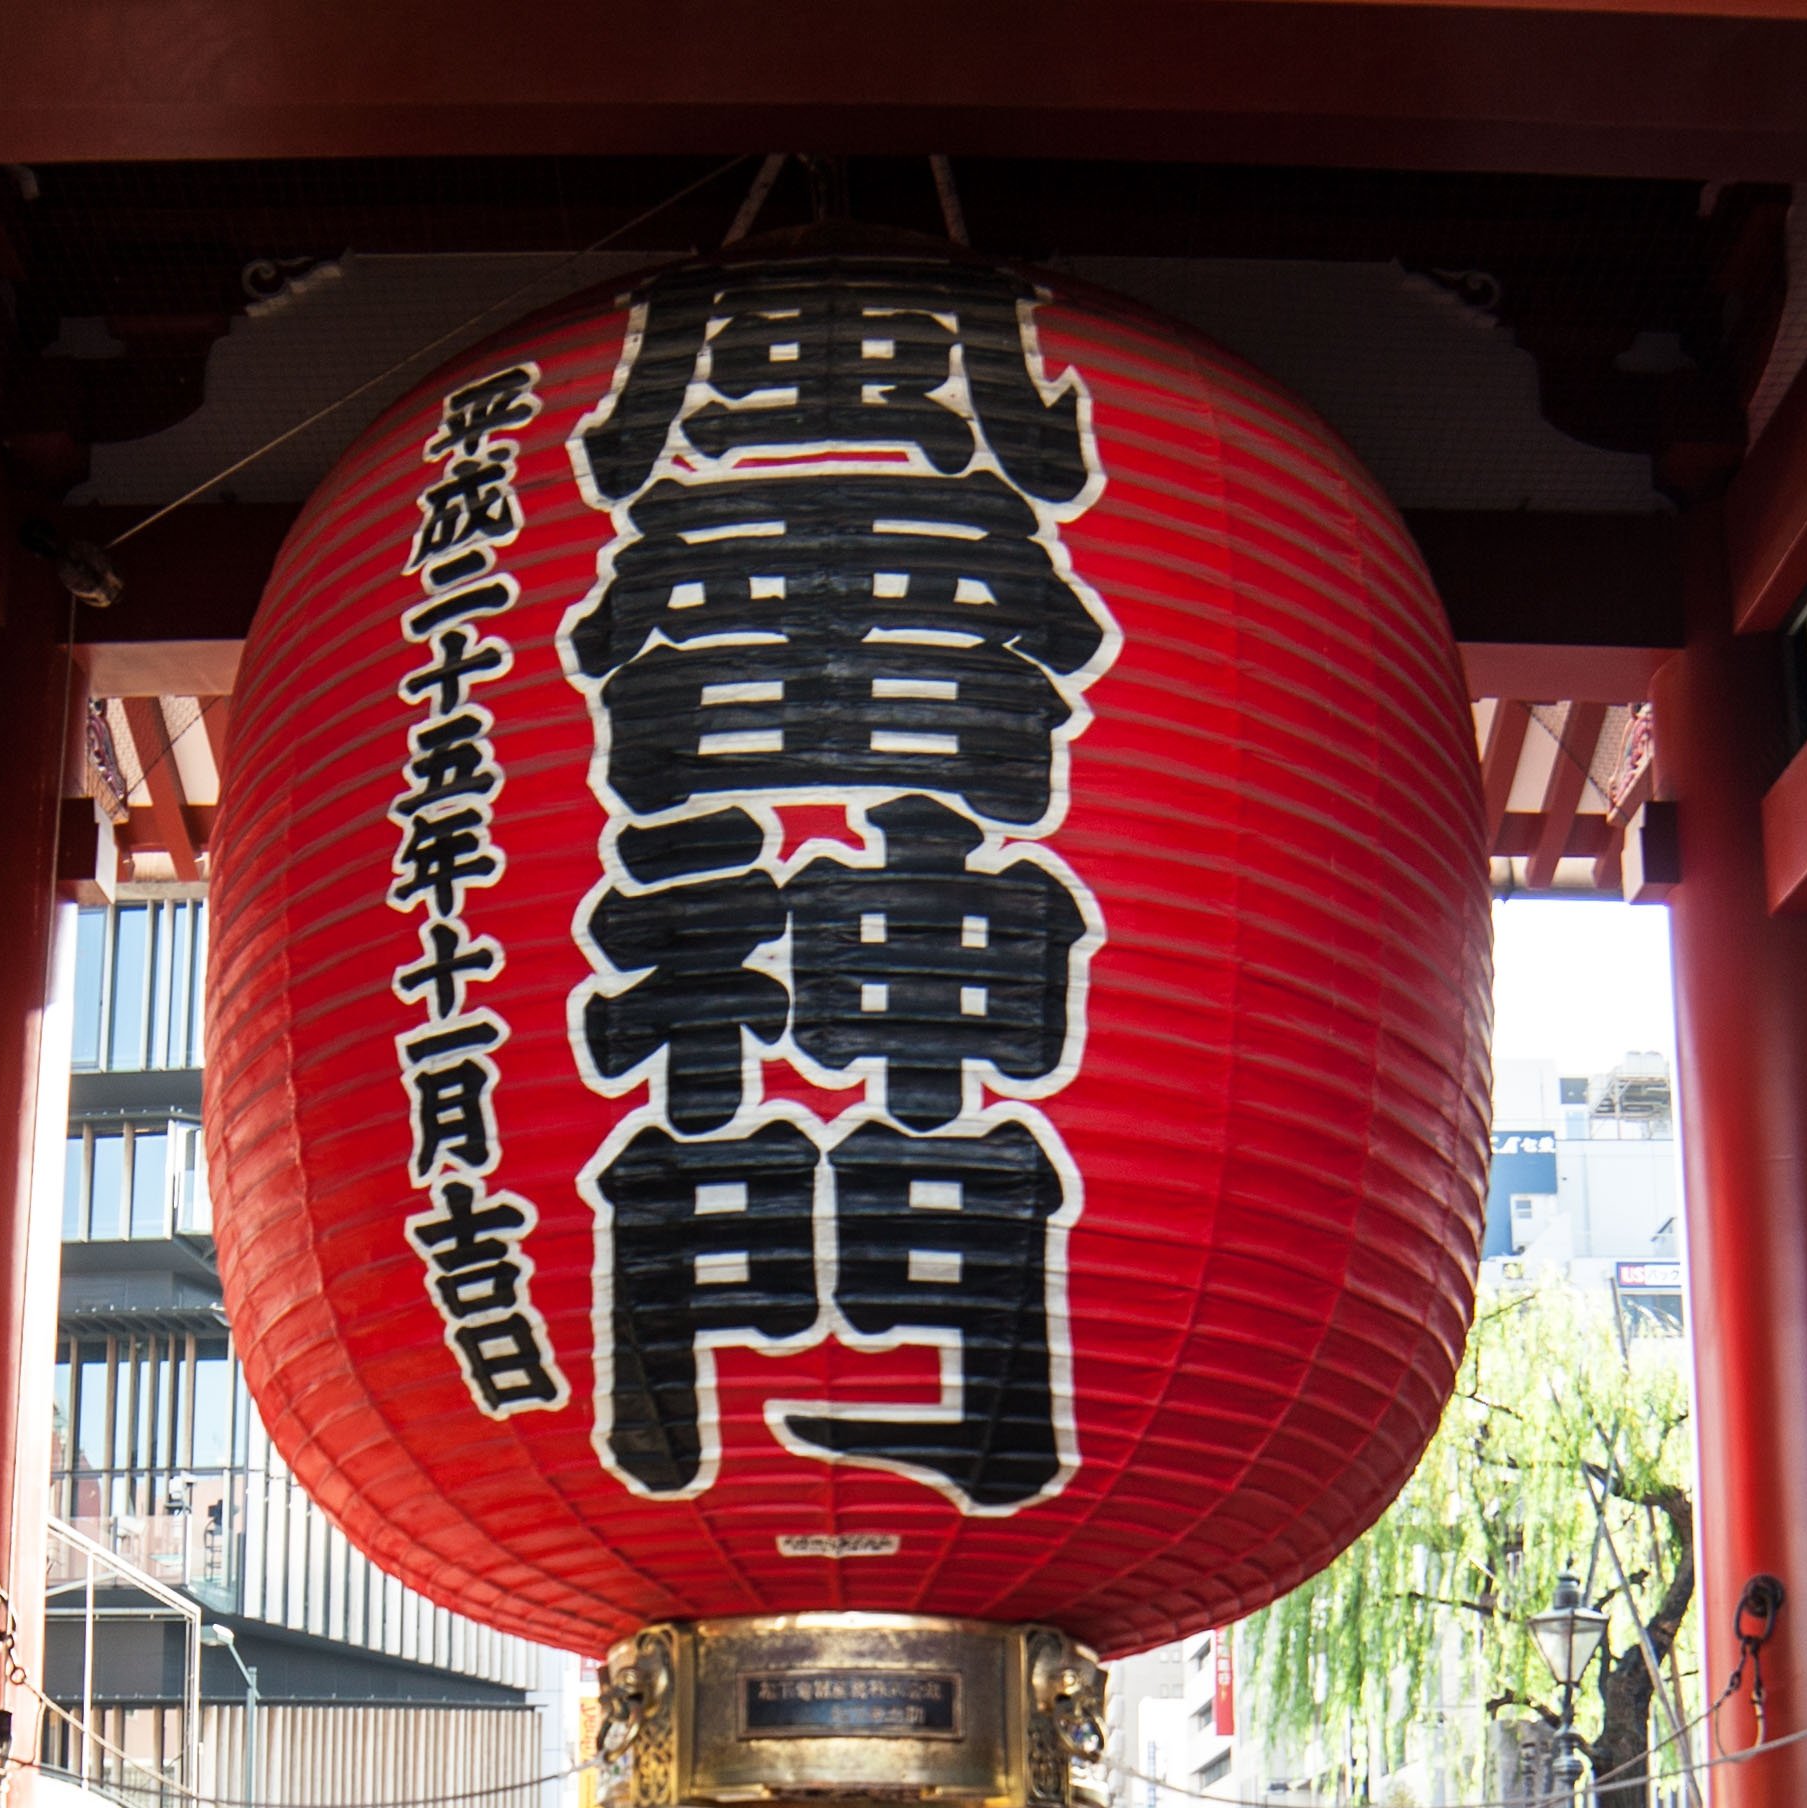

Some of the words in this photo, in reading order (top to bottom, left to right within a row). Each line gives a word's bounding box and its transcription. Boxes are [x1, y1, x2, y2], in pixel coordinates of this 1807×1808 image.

[388, 362, 569, 1419] 平成二十五年十一月吉日
[557, 256, 1123, 1516] 風雷神門
